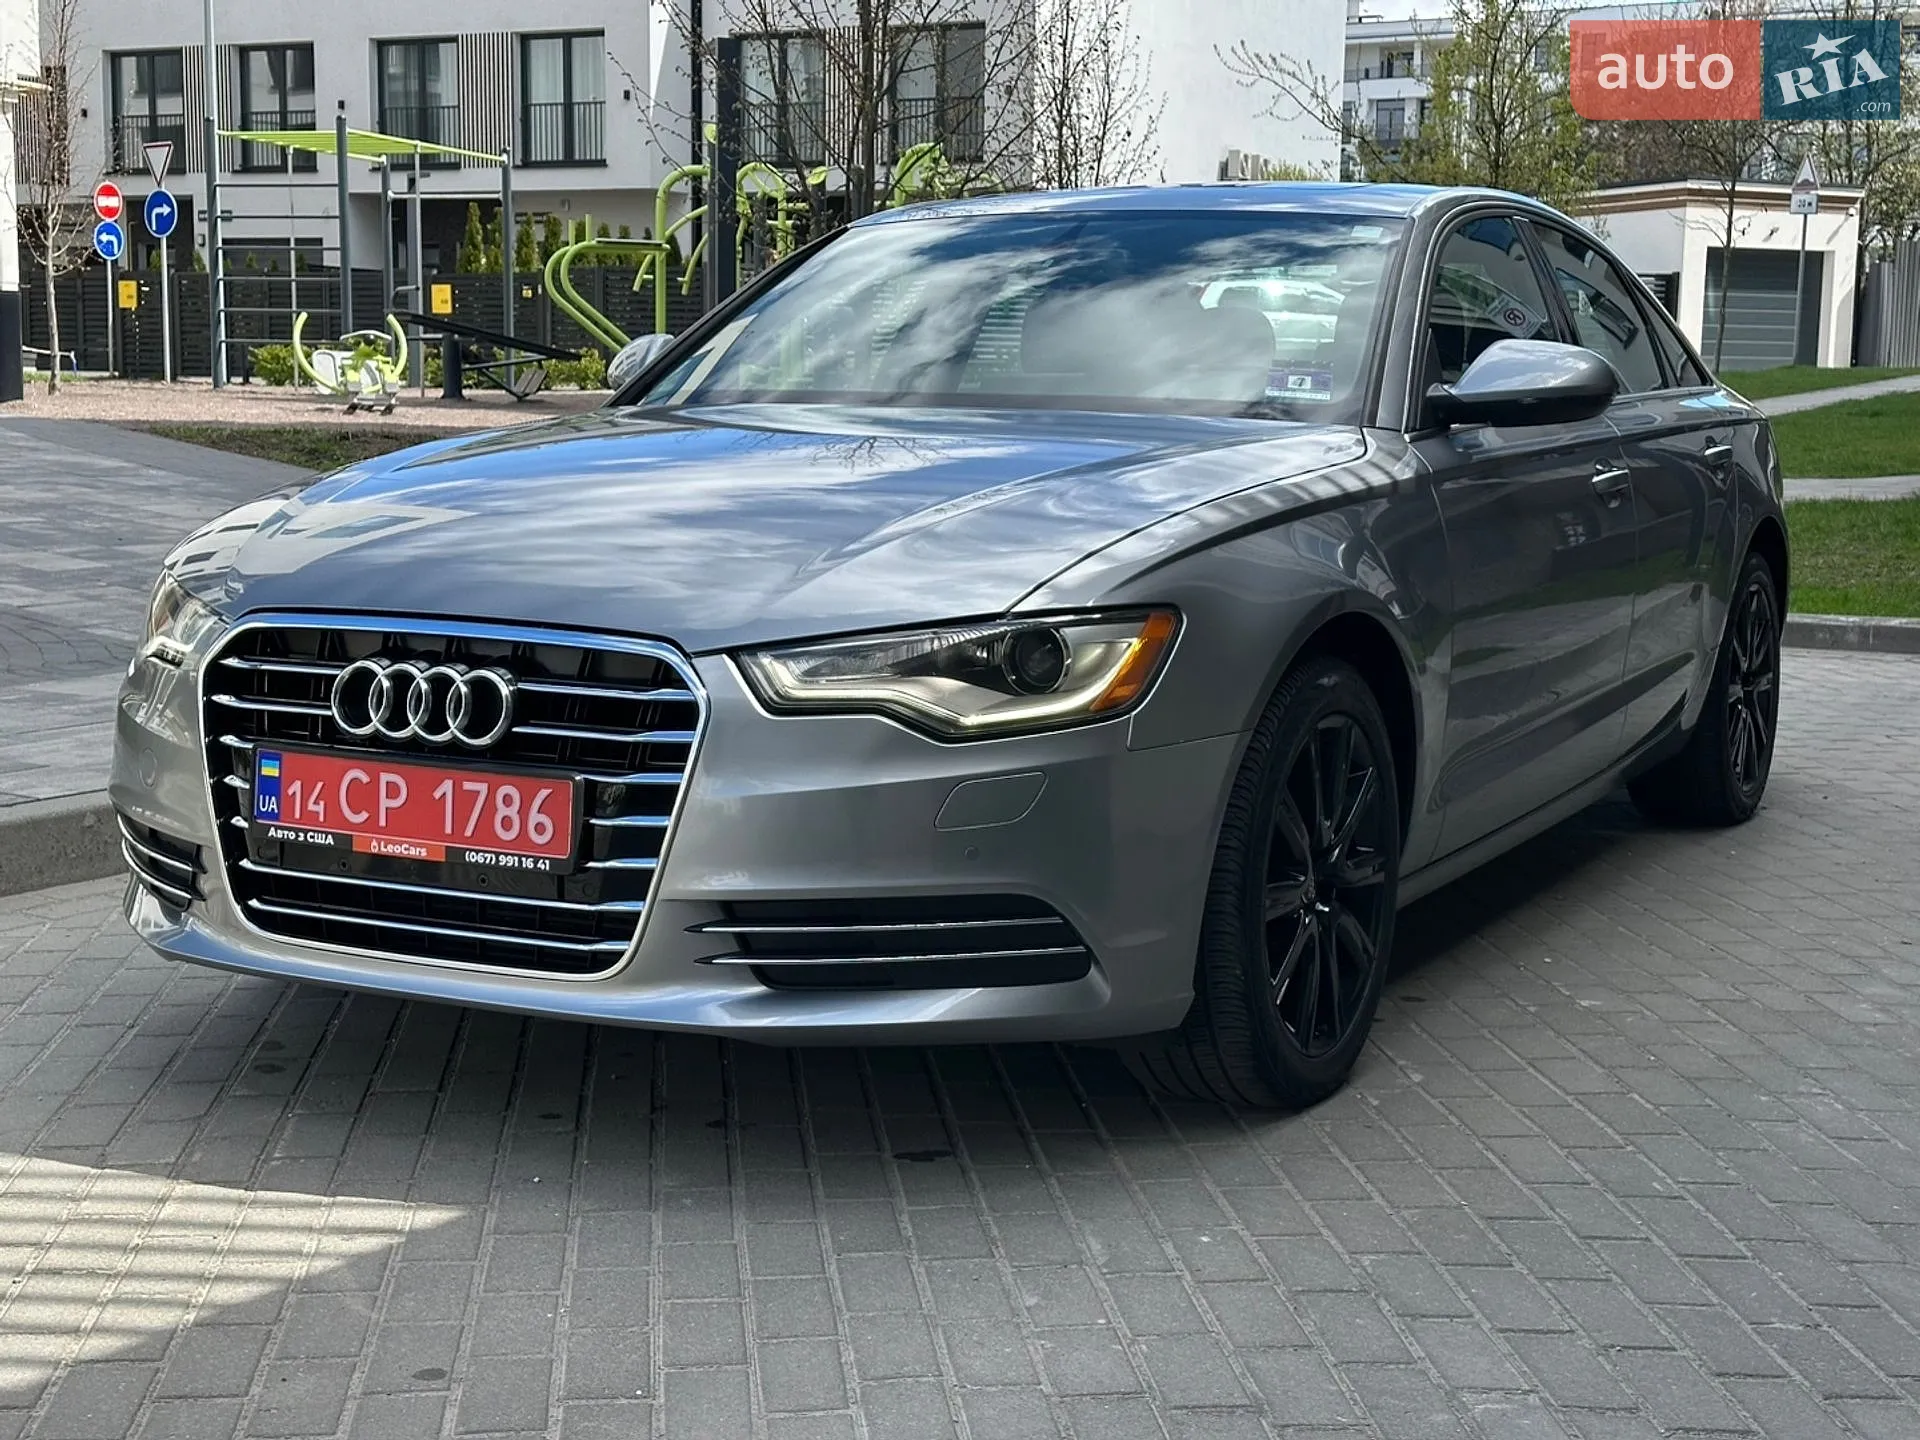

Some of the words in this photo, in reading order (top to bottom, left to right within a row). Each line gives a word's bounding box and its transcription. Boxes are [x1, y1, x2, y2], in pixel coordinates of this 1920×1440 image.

[259, 795, 279, 814] UA
[286, 779, 326, 823] 14
[338, 768, 409, 828] CP
[432, 778, 555, 846] 1786
[268, 827, 296, 841] Авто
[306, 830, 334, 846] США
[380, 842, 428, 858] LeoCars
[465, 850, 496, 866] (067)
[498, 853, 519, 868] 991
[521, 856, 536, 870] 16
[536, 858, 551, 872] 41
